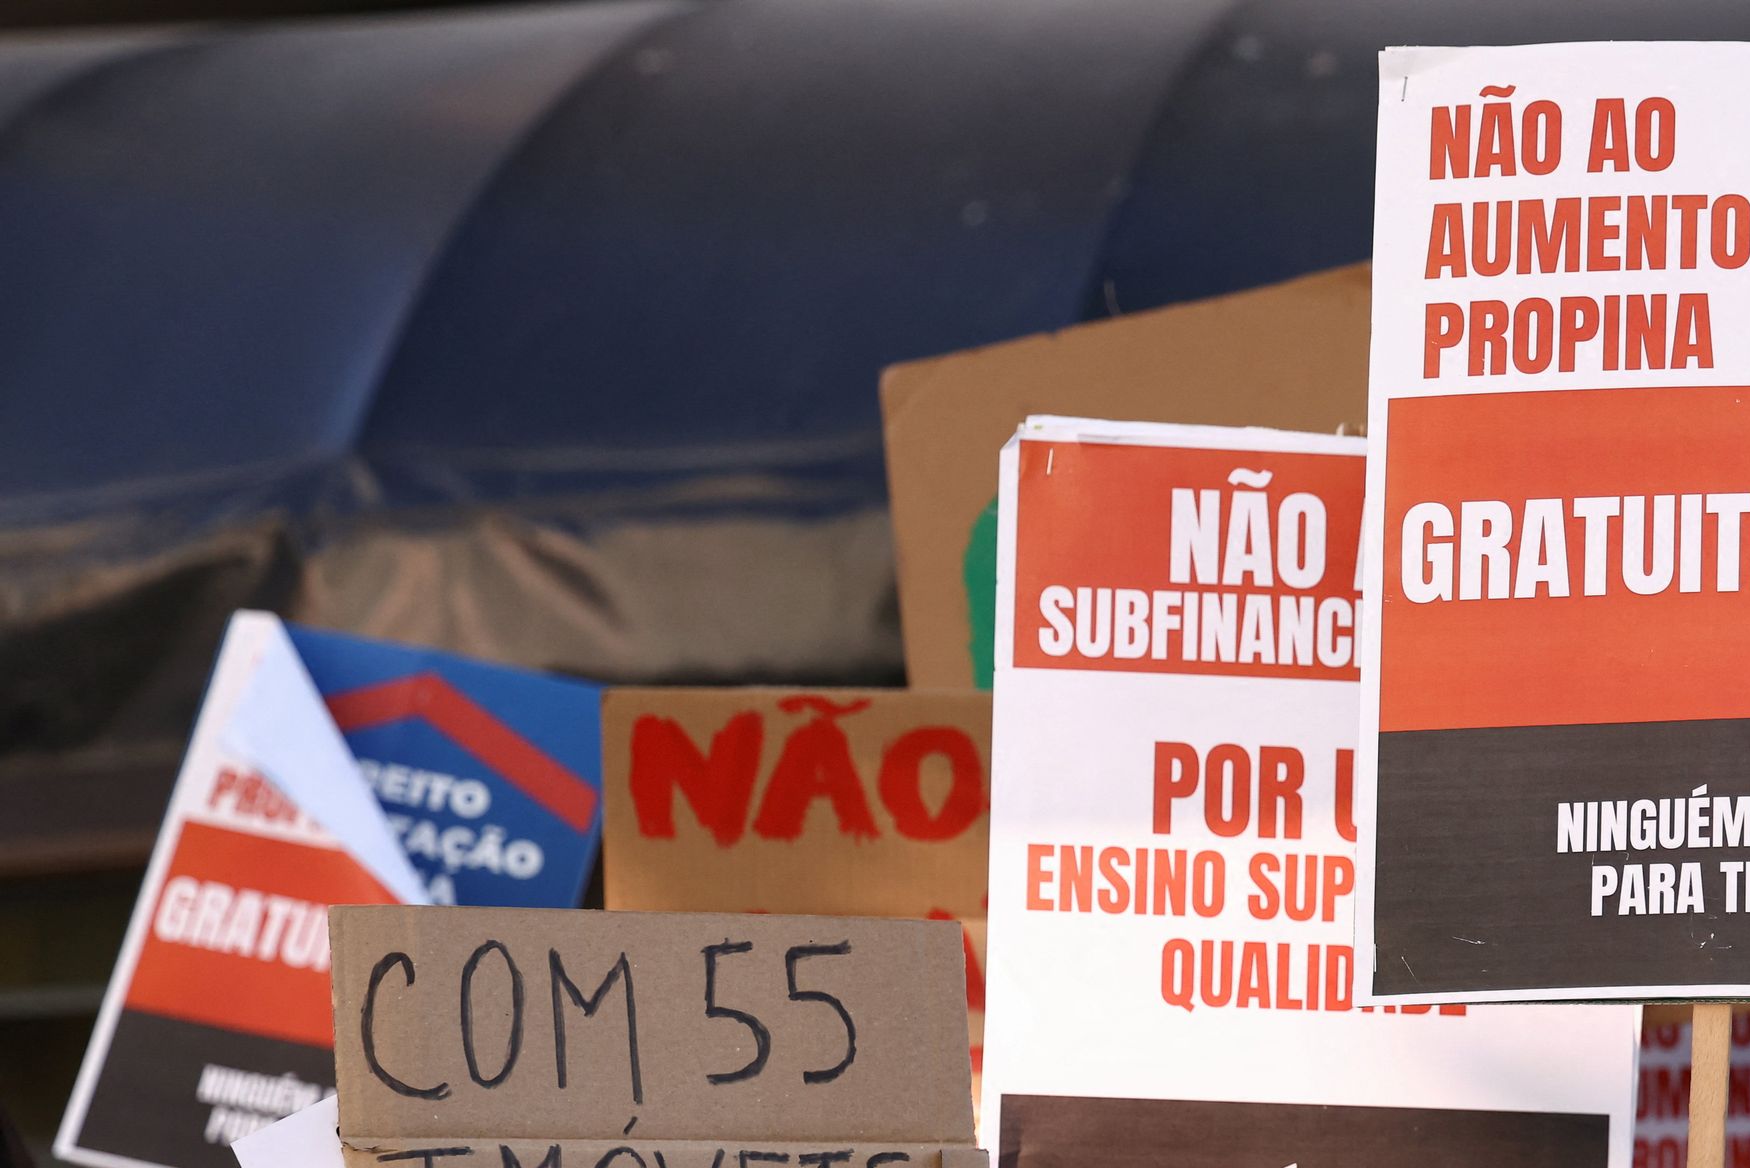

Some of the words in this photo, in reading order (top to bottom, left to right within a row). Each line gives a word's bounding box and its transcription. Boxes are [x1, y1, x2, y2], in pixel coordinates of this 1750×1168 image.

[1430, 84, 1562, 180] NÃO
[1587, 97, 1676, 173] AO
[1423, 293, 1714, 379] PROPINA
[1169, 467, 1327, 589] NÃO
[629, 694, 989, 848] NÃO
[1153, 741, 1305, 841] POR
[1026, 843, 1225, 917] ENSINO
[1248, 852, 1356, 922] SUP
[1591, 862, 1705, 917] PARA
[361, 939, 644, 1105] COM
[700, 937, 858, 1085] 55
[1161, 938, 1467, 1016] QUALID
